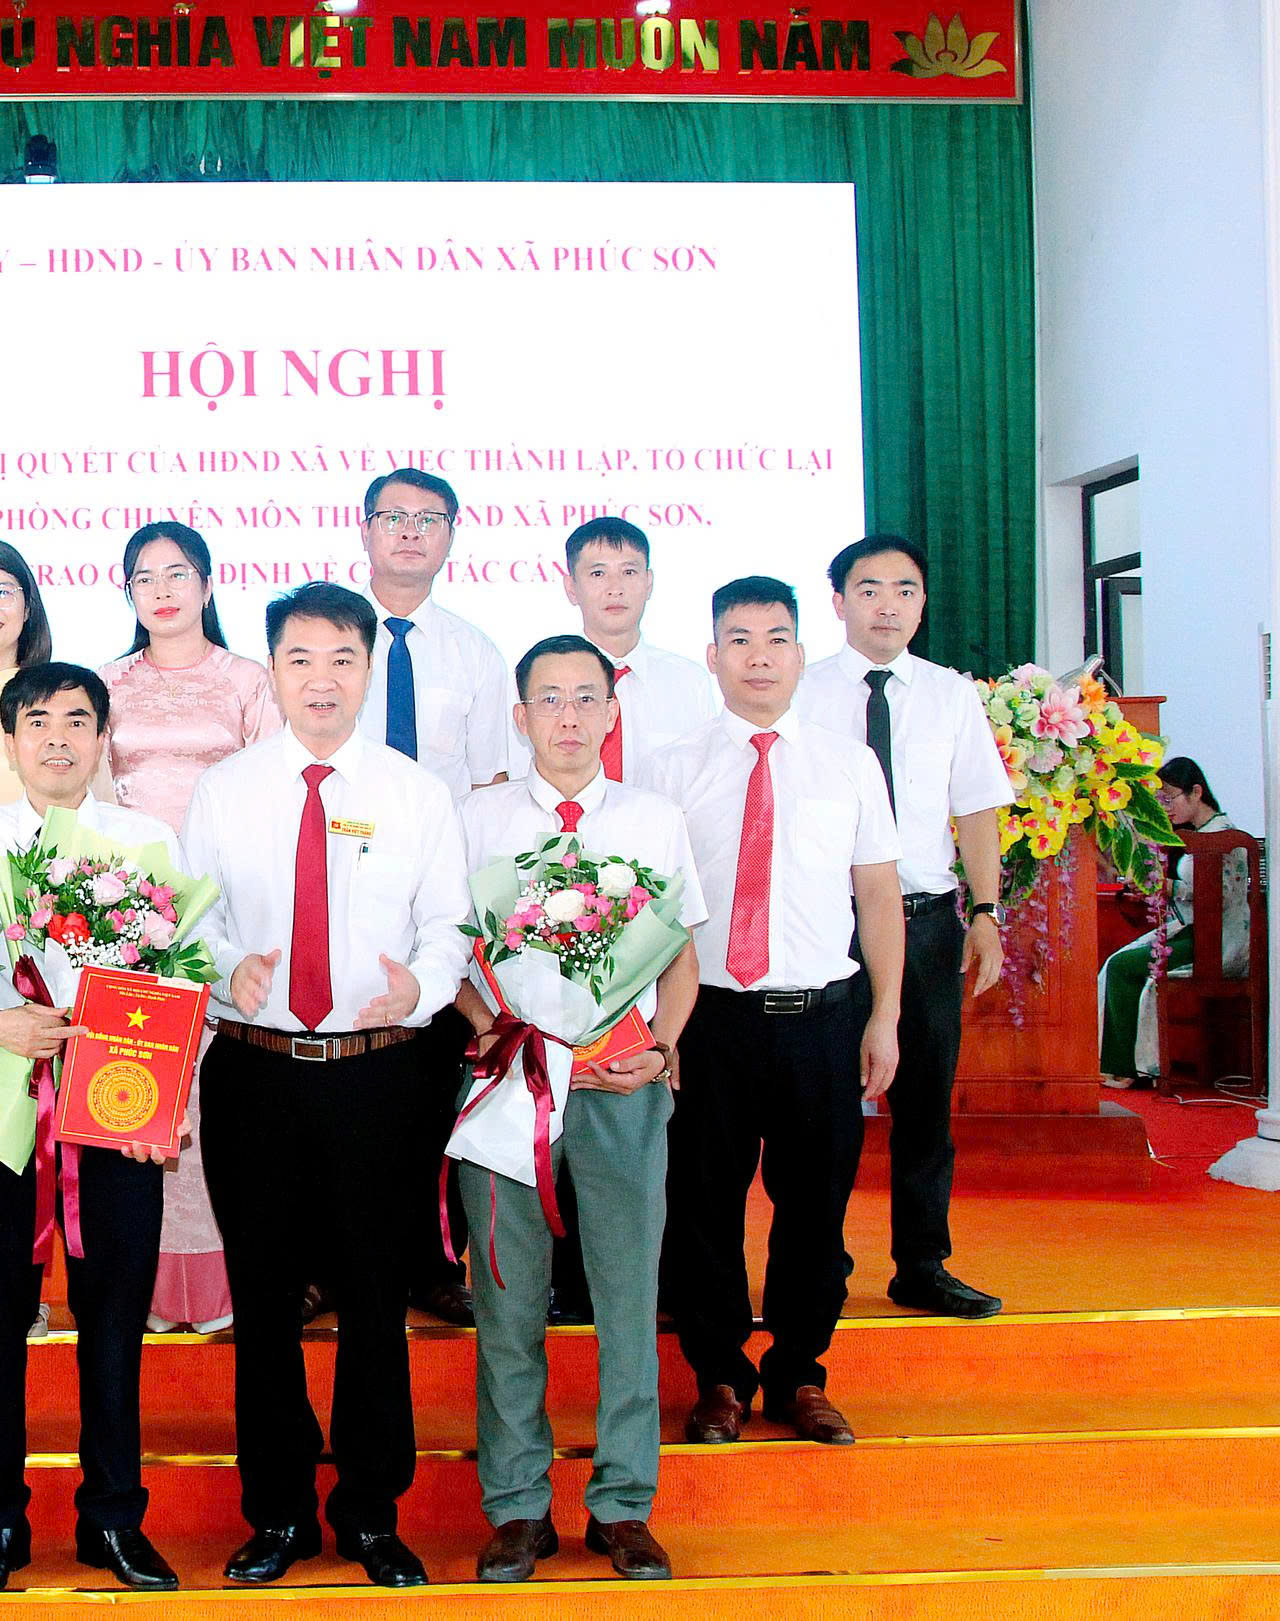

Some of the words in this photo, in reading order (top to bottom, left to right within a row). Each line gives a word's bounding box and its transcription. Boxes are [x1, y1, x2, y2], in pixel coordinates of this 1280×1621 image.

[56, 3, 235, 70] NGHĨA
[253, 2, 374, 78] VIỆT
[393, 16, 526, 68] NAM
[547, 3, 720, 72] MUÔN
[739, 7, 871, 72] NĂM
[48, 247, 143, 273] HĐND
[231, 246, 297, 273] BAN
[309, 238, 404, 272] NHÂN
[417, 238, 484, 272] DÂN
[495, 240, 541, 272] XÃ
[553, 239, 643, 272] PHÚC
[653, 244, 717, 272] SƠN
[140, 341, 257, 412] HỘI
[280, 348, 447, 411] NGHỊ
[198, 449, 281, 473] HĐND
[290, 444, 329, 473] XÃ
[464, 442, 566, 472] THÀNH
[694, 441, 777, 472] CHỨC
[786, 447, 833, 477] LẠI
[235, 499, 302, 529] MÔN
[513, 499, 552, 528] XÃ
[29, 563, 100, 587] RAO
[220, 562, 290, 591] ĐỊNH
[446, 554, 501, 583] TÁC
